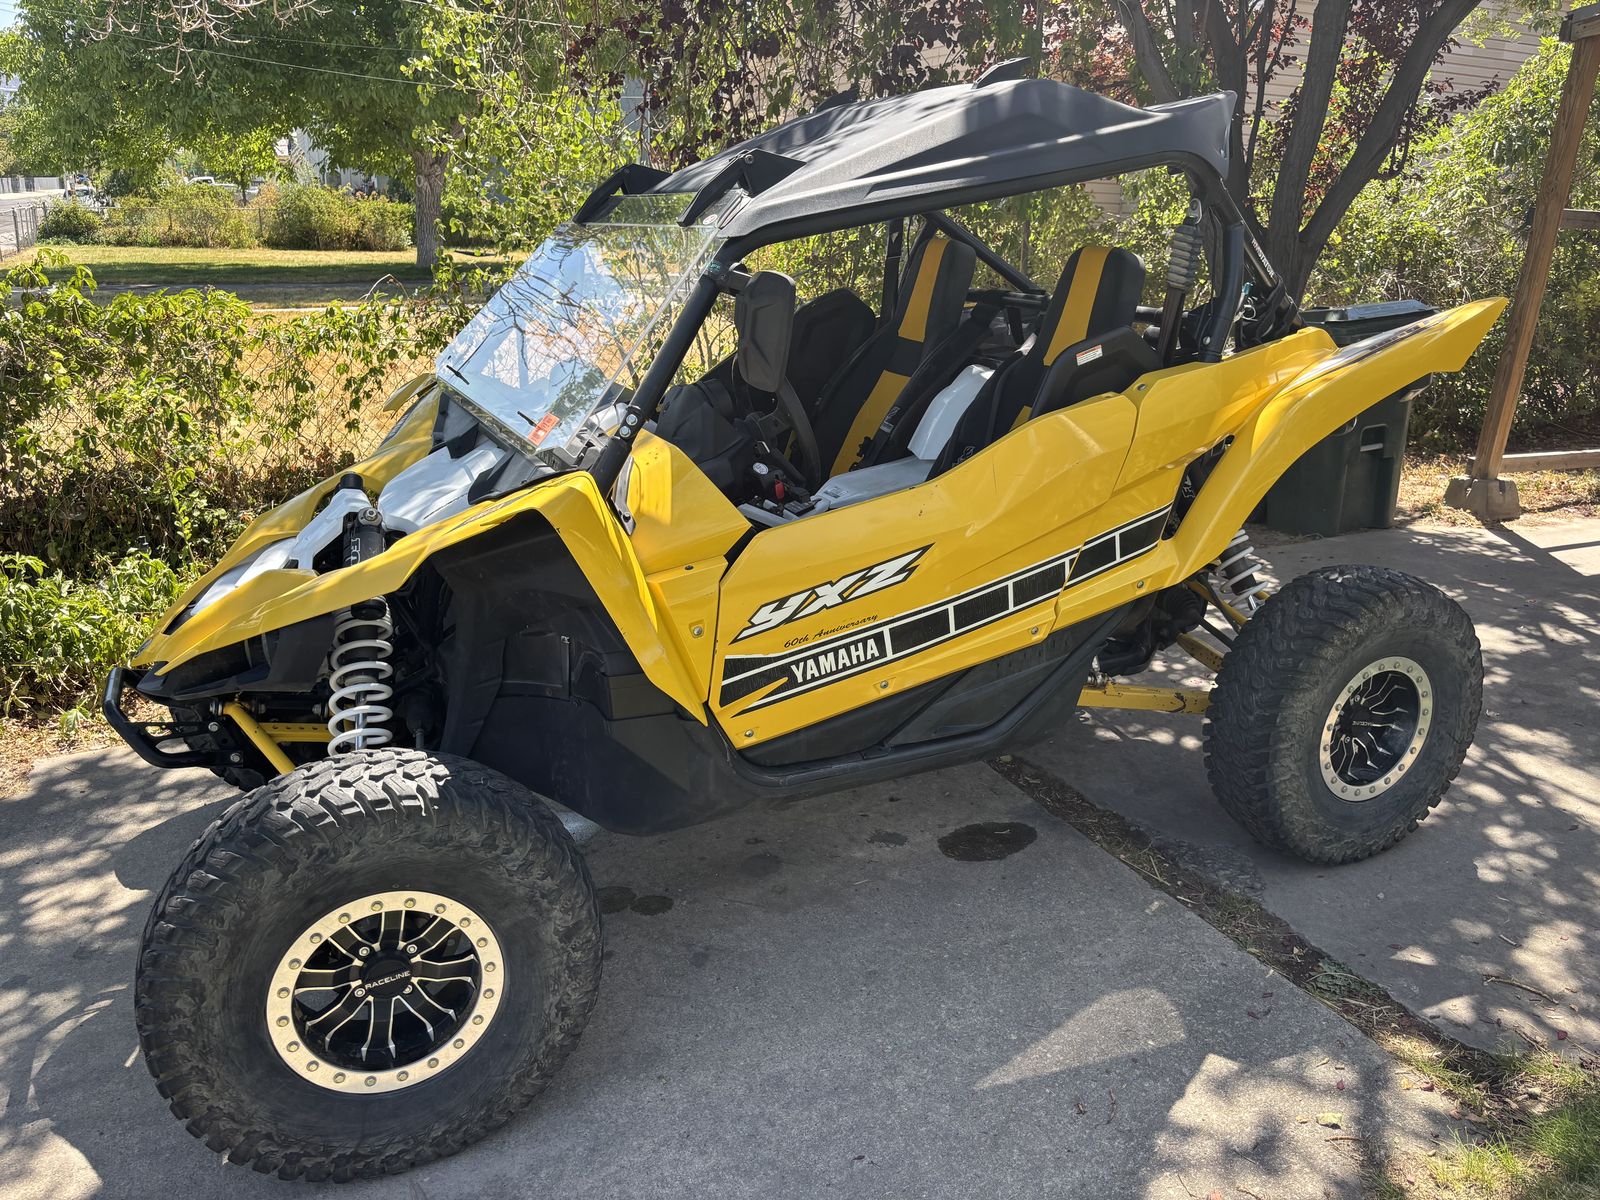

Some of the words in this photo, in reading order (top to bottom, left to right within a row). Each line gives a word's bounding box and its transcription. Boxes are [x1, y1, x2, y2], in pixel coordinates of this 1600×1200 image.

[729, 542, 935, 645] YXZ
[784, 632, 809, 648] 60th
[813, 613, 878, 639] Anniversary
[791, 638, 880, 684] YAMAHA
[364, 970, 411, 989] RACELINE
